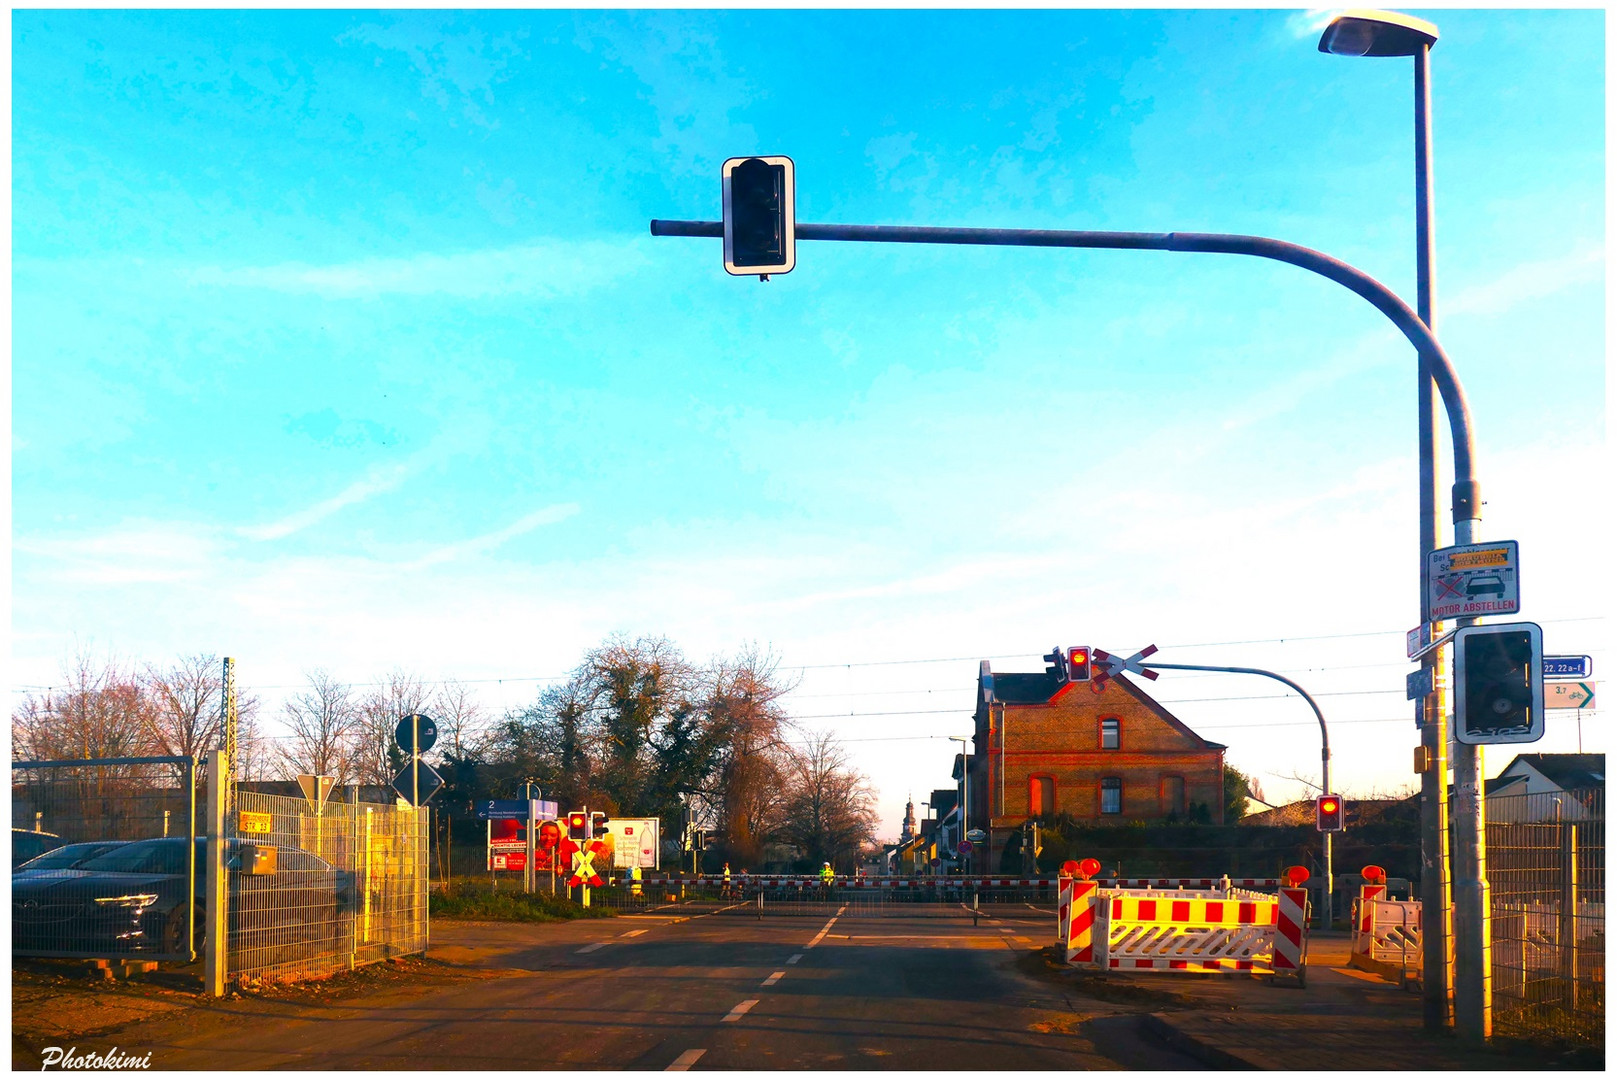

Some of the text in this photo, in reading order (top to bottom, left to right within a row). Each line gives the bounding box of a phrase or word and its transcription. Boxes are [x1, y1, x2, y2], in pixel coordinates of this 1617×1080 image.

[1433, 553, 1445, 563] Bei
[1432, 600, 1515, 616] MOTOR ABSTELLEN
[488, 800, 495, 809] 2
